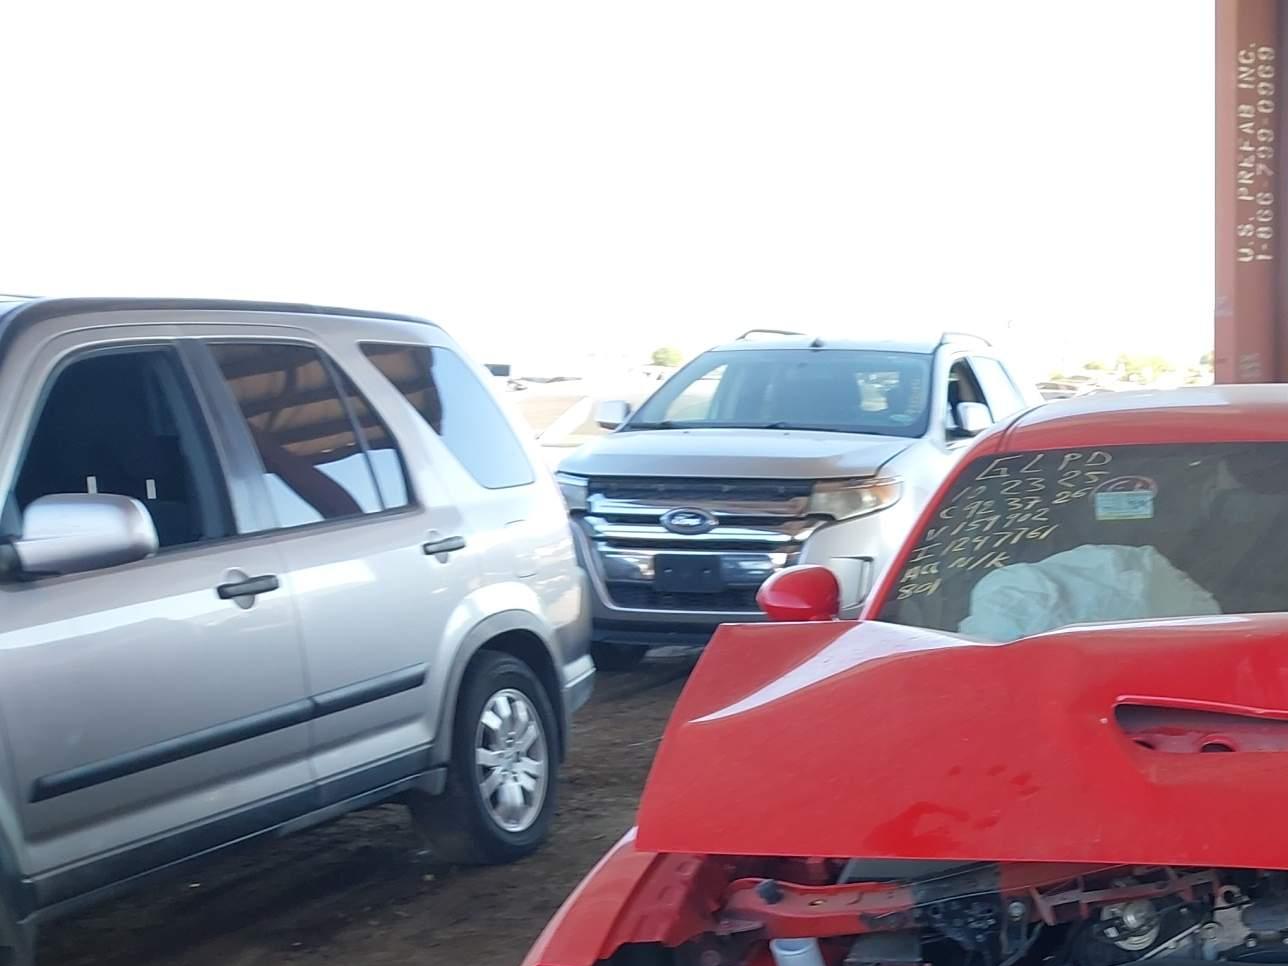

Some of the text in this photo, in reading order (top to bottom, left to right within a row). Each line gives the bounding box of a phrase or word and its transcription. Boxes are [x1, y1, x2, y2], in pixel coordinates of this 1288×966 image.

[1236, 43, 1256, 262] U.S. PREFAB INC.
[1255, 46, 1275, 260] 1-866-799-0969
[1000, 477, 1046, 495] 23
[1057, 470, 1110, 487] 25
